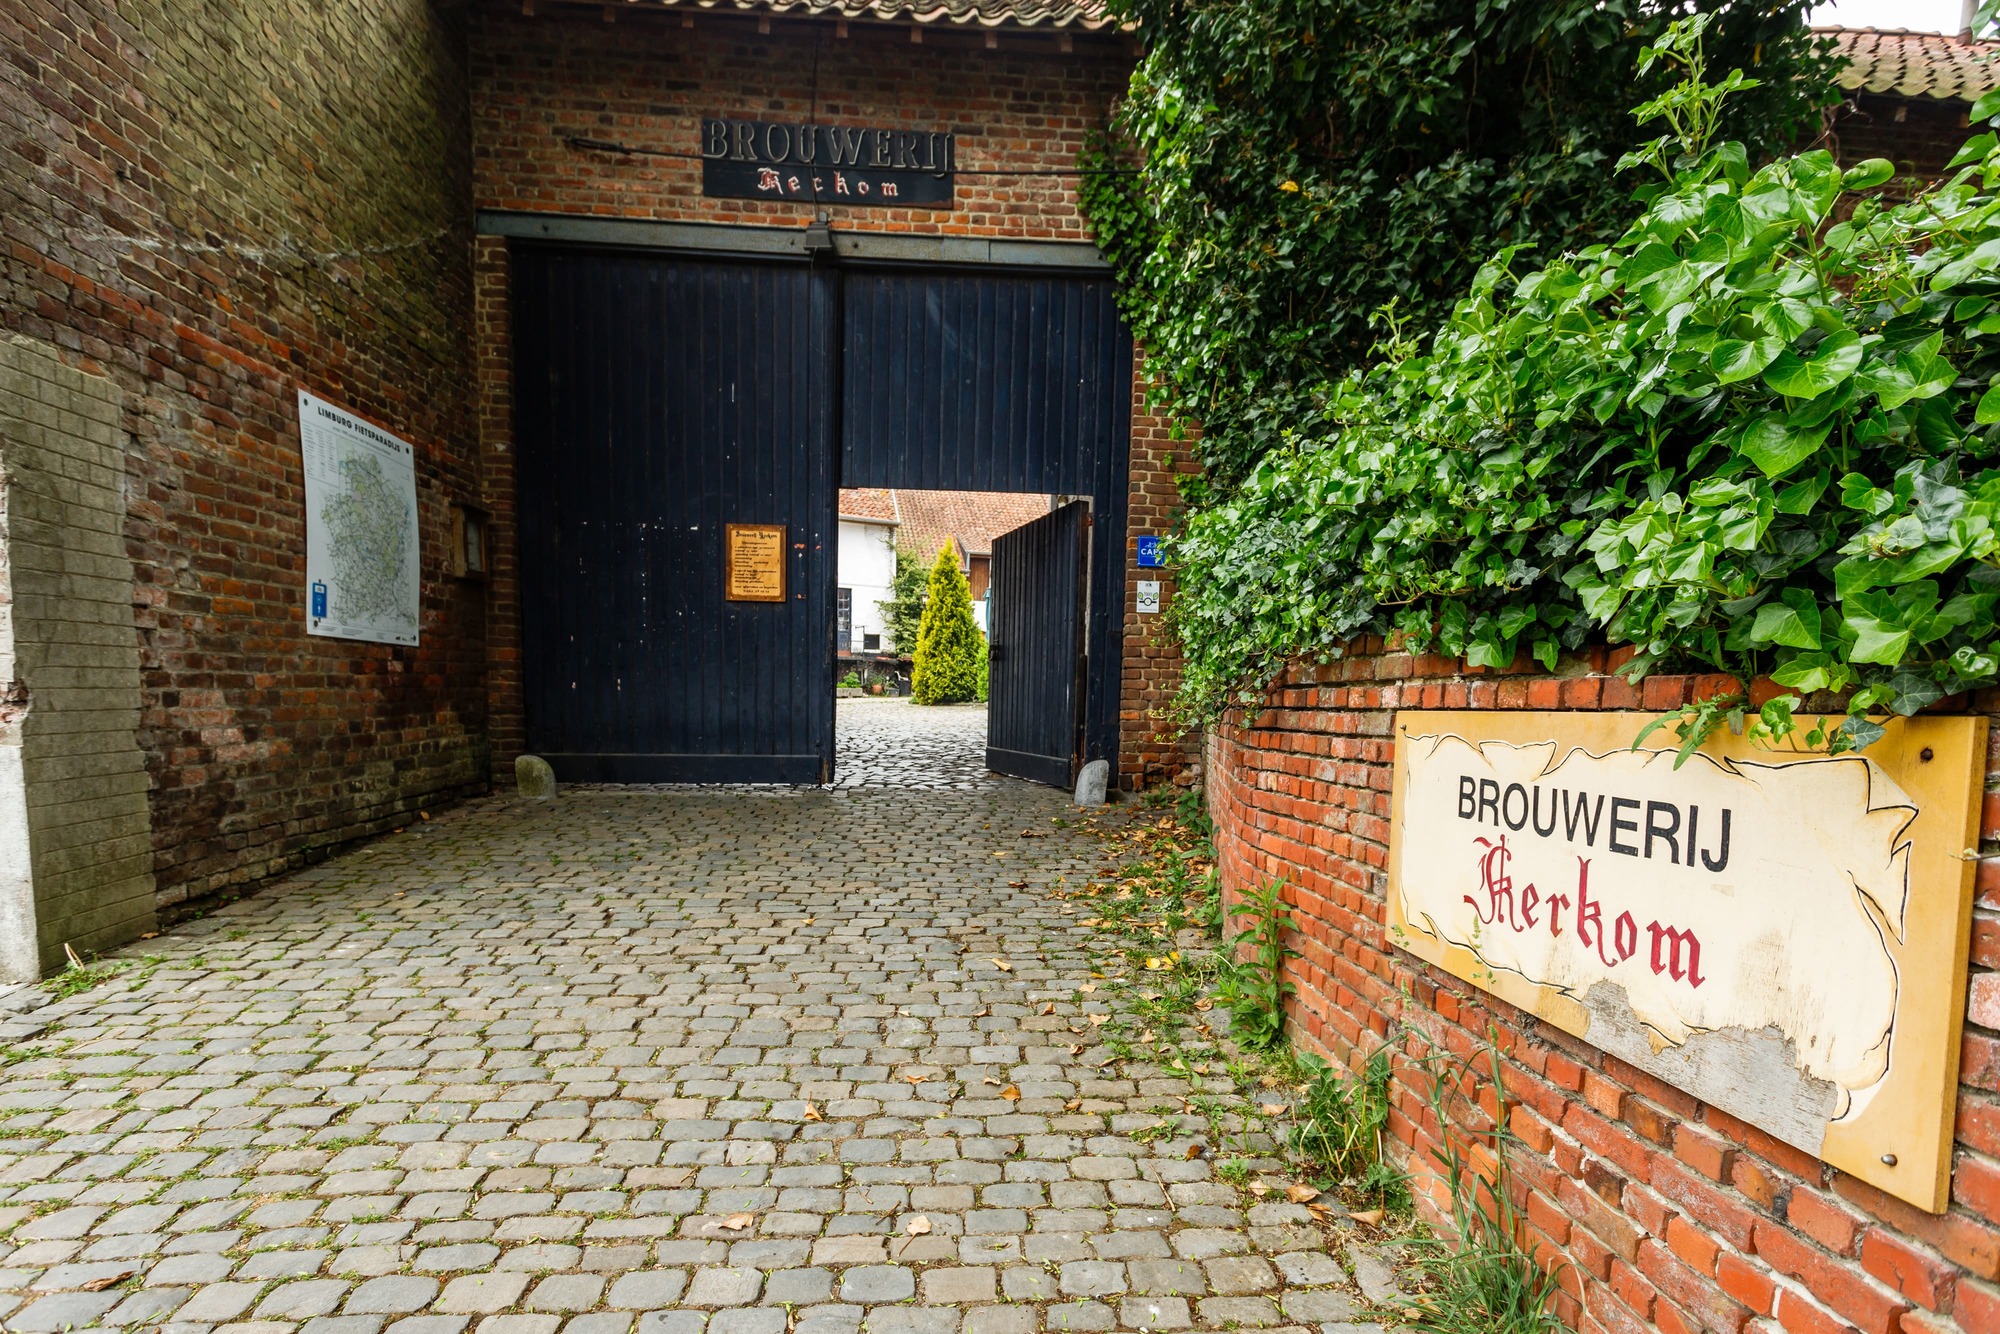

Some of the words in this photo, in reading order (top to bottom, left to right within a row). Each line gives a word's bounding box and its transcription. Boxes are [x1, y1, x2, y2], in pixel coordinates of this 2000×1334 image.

[703, 119, 953, 179] BROUWERIJ
[317, 406, 353, 429] LIMBURG
[354, 424, 401, 453] FIETSPARADIJS
[1457, 774, 1732, 873] BROUWERIJ
[1463, 833, 1706, 990] Kerkom
